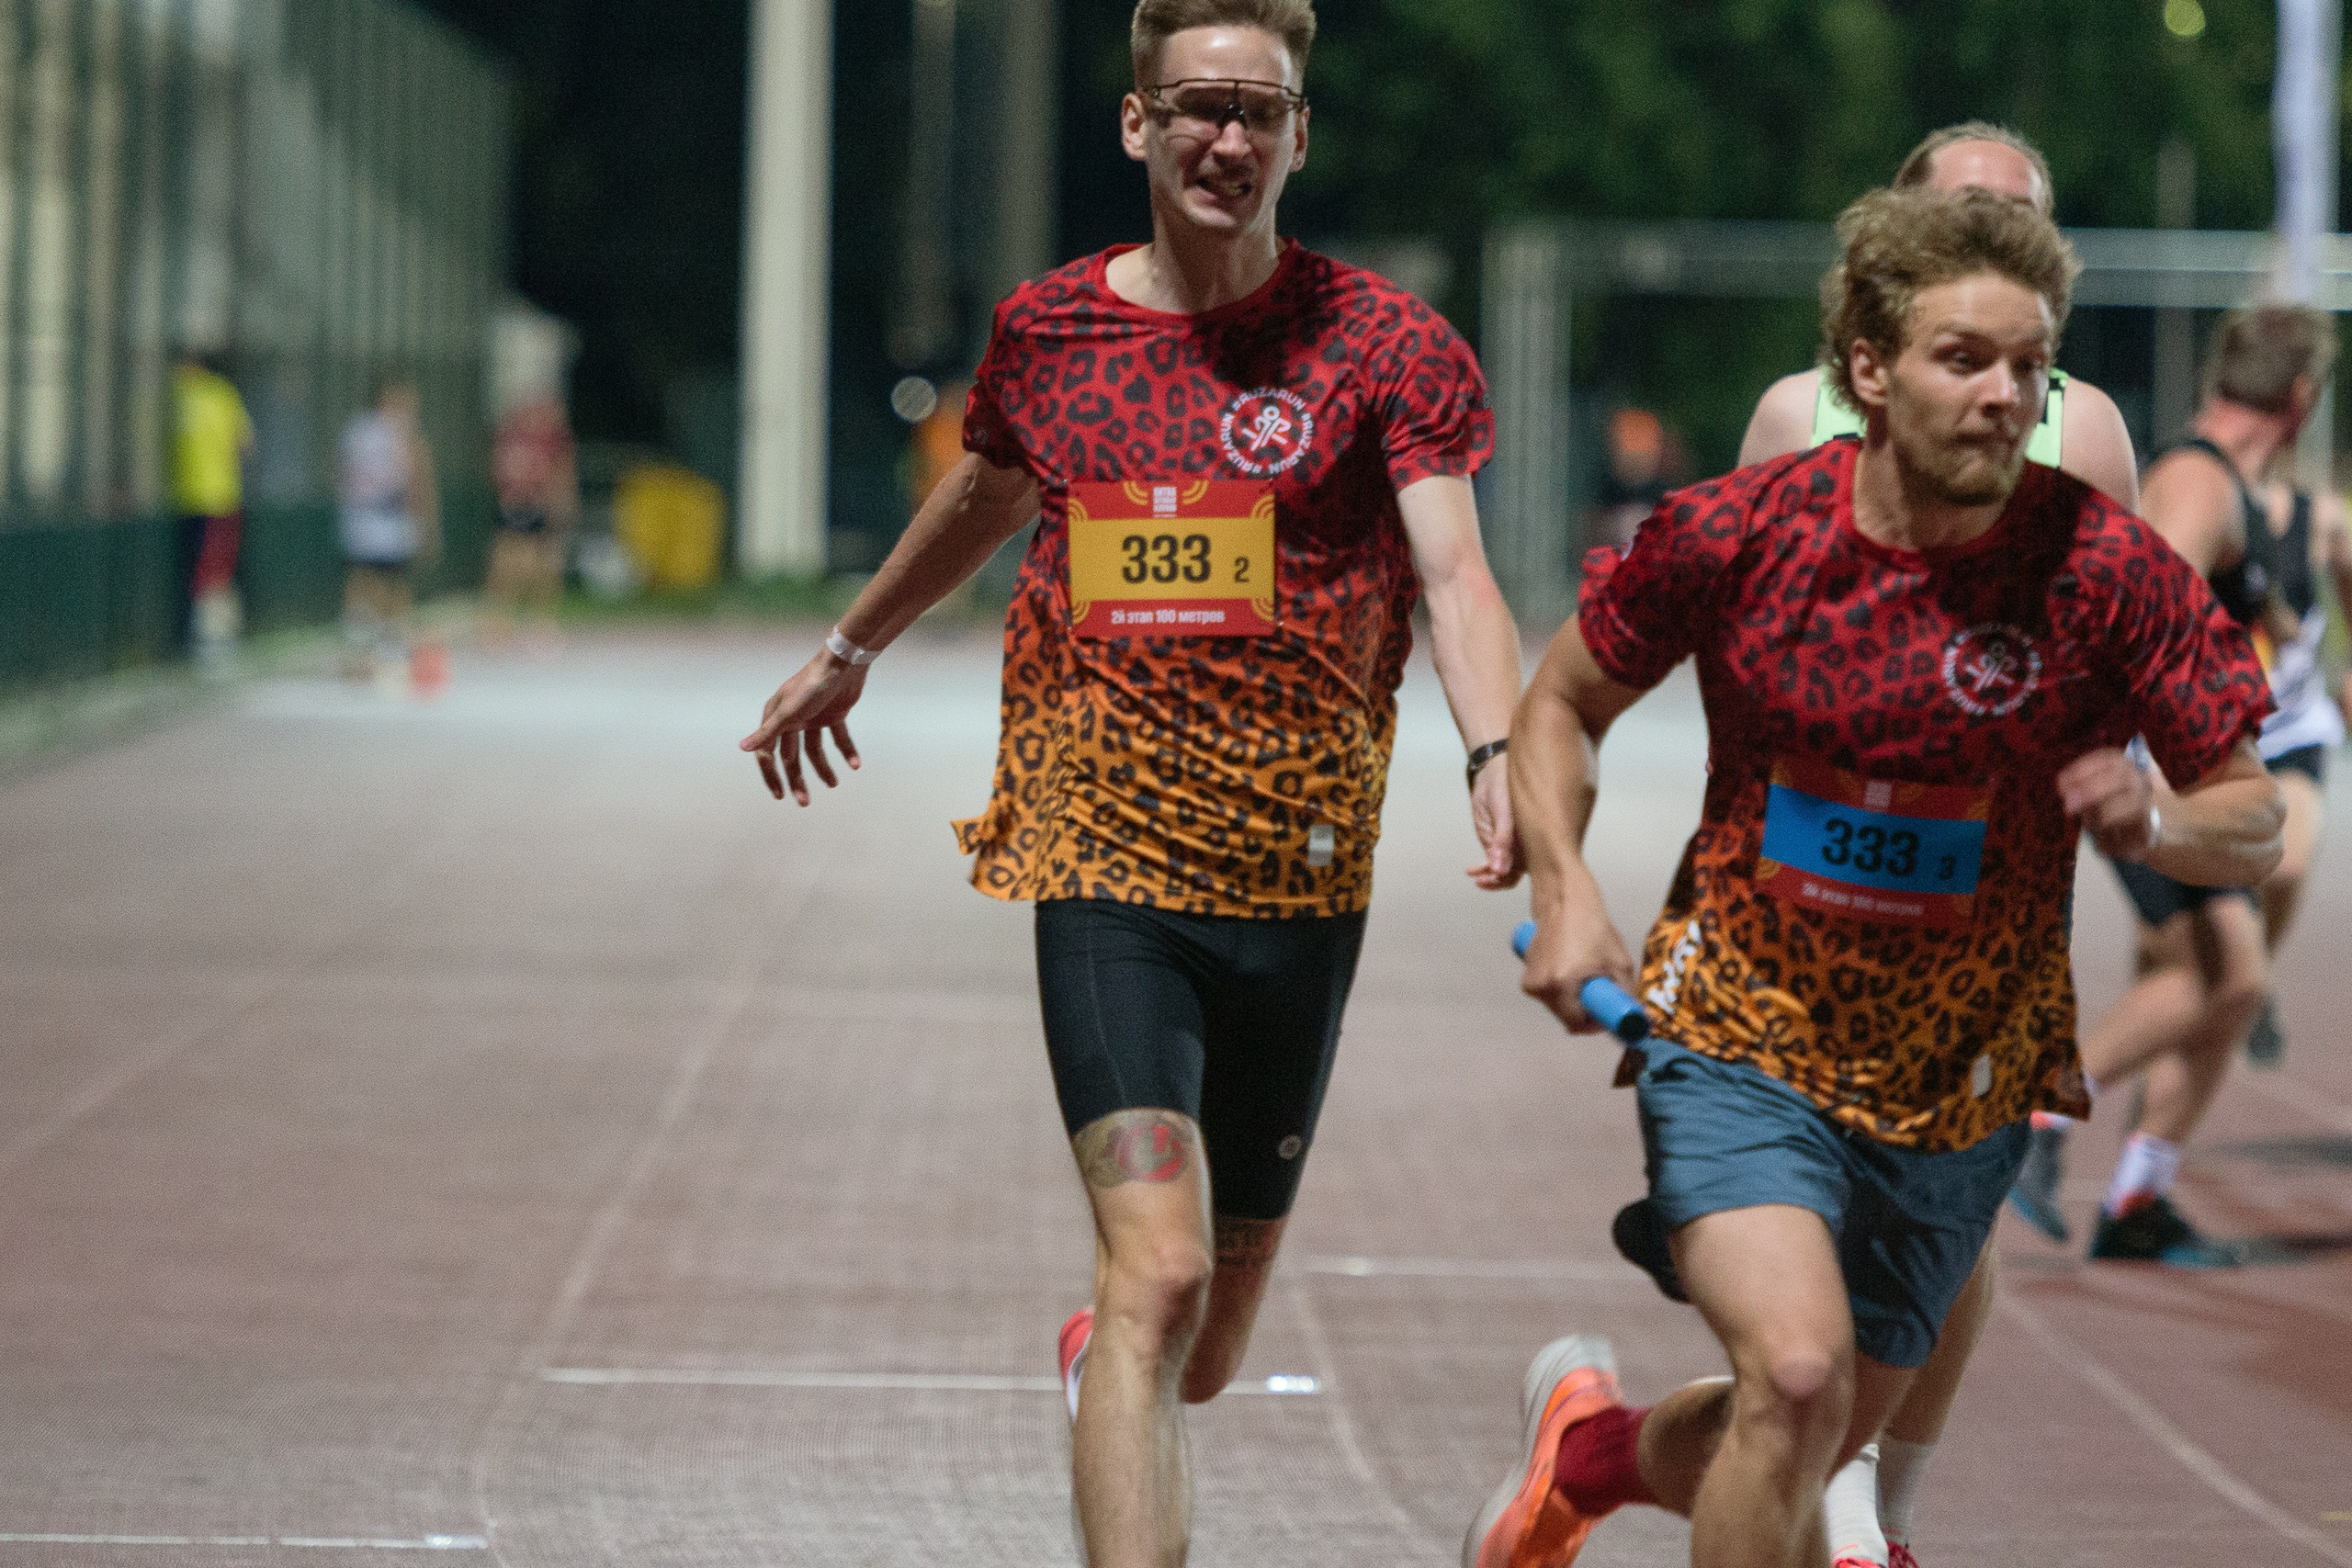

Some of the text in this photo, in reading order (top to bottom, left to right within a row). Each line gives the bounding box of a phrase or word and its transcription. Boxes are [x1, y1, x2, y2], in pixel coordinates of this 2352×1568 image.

[1122, 534, 1250, 583] 333 2
[1822, 818, 1956, 880] 333 3
